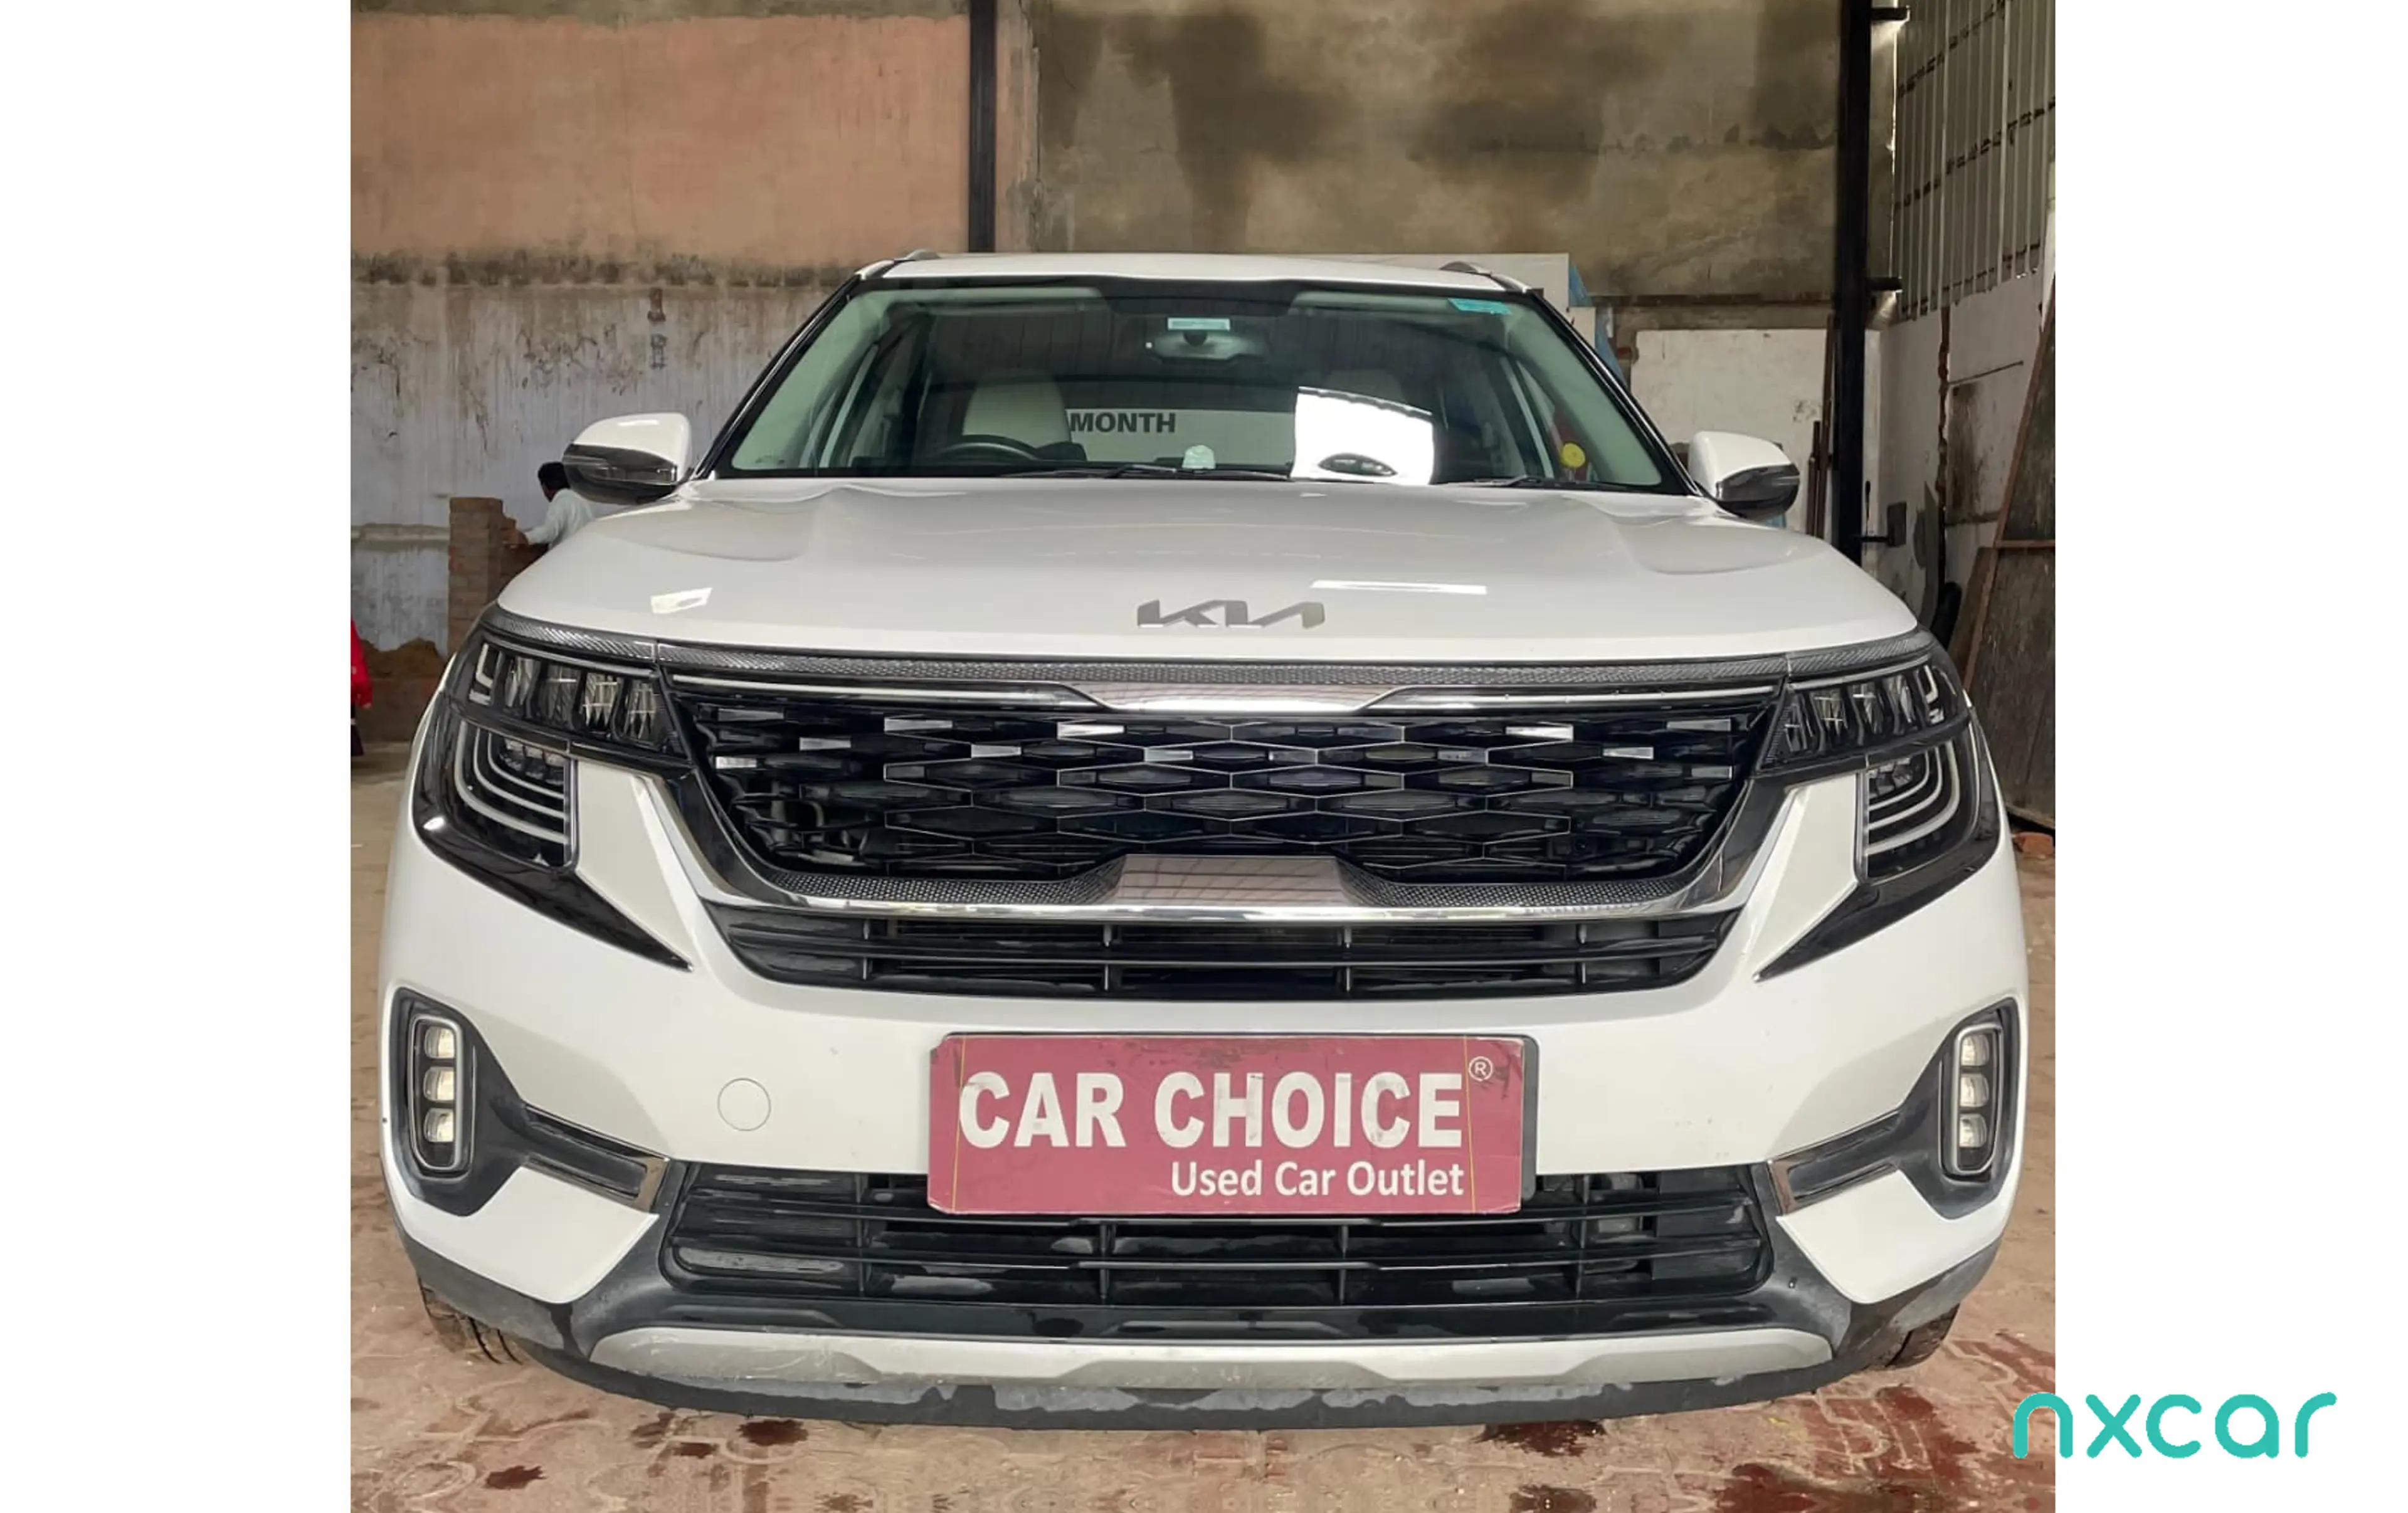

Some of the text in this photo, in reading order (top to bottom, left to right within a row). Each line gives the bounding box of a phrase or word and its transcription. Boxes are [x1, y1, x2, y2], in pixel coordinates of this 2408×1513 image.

[1070, 412, 1176, 433] MONTH
[959, 1071, 1127, 1149] CAR
[1154, 1071, 1463, 1149] CHOICE
[1171, 1159, 1464, 1196] Used Car Outlet
